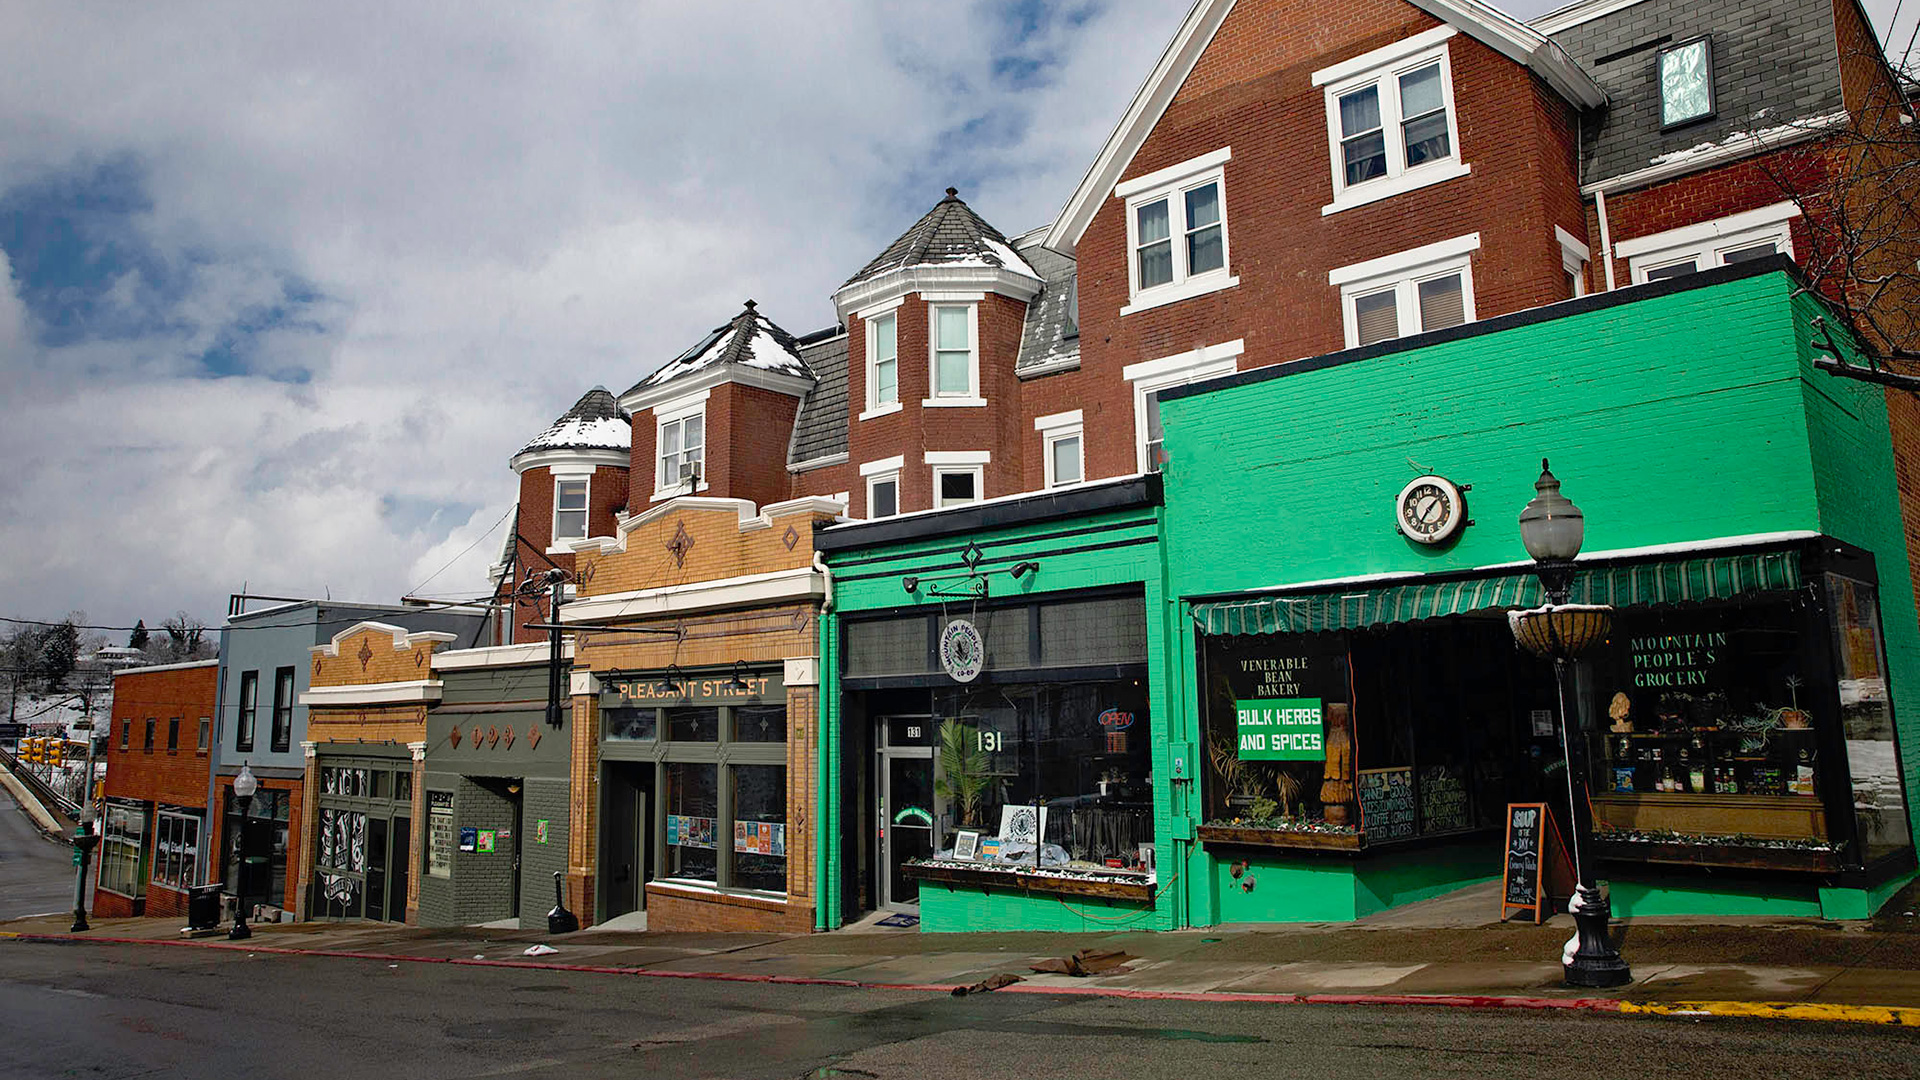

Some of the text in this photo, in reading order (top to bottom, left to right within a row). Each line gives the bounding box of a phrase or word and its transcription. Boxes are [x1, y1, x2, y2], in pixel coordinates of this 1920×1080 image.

[1416, 489, 1423, 498] 11
[1423, 486, 1432, 495] 12
[1409, 498, 1418, 507] 10
[1406, 508, 1413, 517] 9
[1411, 517, 1417, 526] 8
[1428, 525, 1435, 533] 6
[944, 625, 958, 665] MOUNTAIN
[1631, 632, 1727, 651] MOUNTAIN
[1240, 656, 1309, 672] VENERABLE
[957, 669, 975, 677] CO-OP
[1264, 671, 1292, 683] BEAN
[1634, 670, 1707, 687] GROCERY
[1257, 683, 1301, 696] BAKERY
[1100, 711, 1131, 726] OPEN
[1238, 708, 1322, 726] BULK HERBS
[472, 725, 513, 746] 123
[907, 727, 921, 738] 131
[977, 731, 1002, 752] 131
[1240, 733, 1322, 750] AND SPICES
[1512, 809, 1537, 829] SOUP
